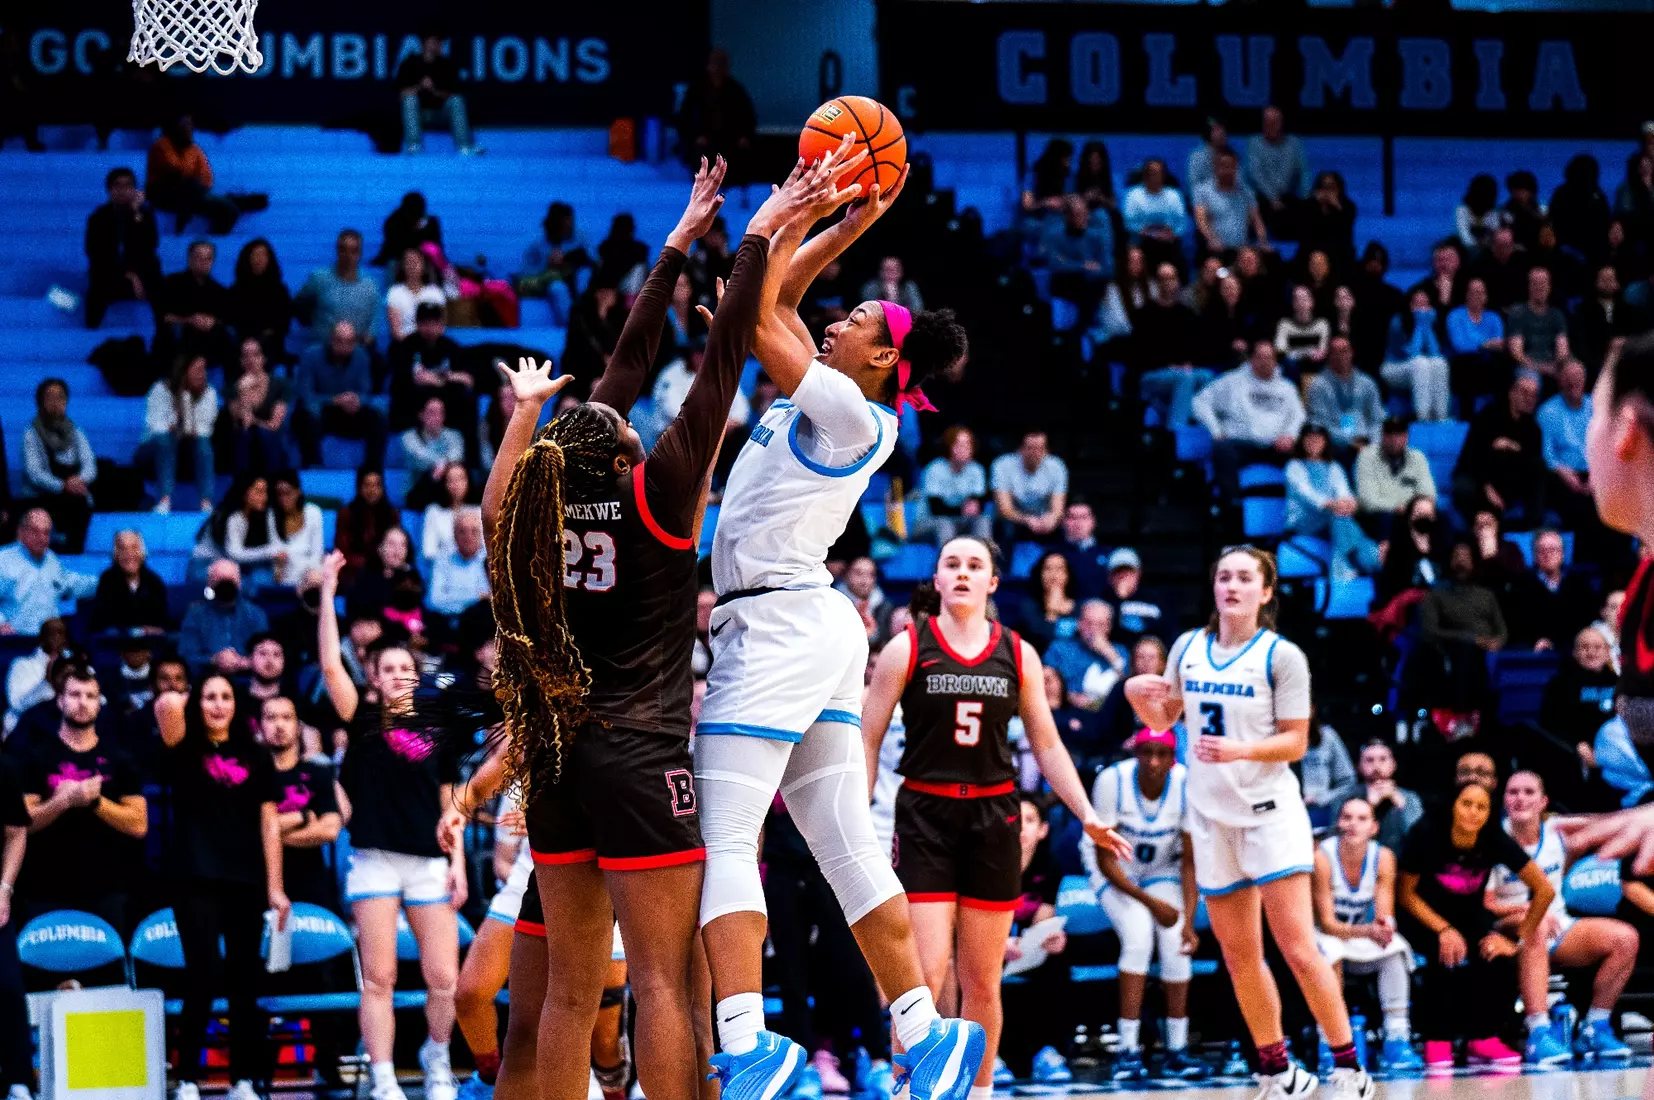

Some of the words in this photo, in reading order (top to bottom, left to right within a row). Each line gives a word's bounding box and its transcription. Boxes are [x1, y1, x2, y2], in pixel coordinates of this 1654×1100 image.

[998, 30, 1589, 112] COLUMBIA
[563, 528, 617, 593] 23
[926, 673, 1010, 698] BROWN
[954, 700, 984, 748] 5
[1199, 701, 1226, 736] 3
[664, 768, 697, 817] B
[27, 922, 108, 945] COLUMBIA
